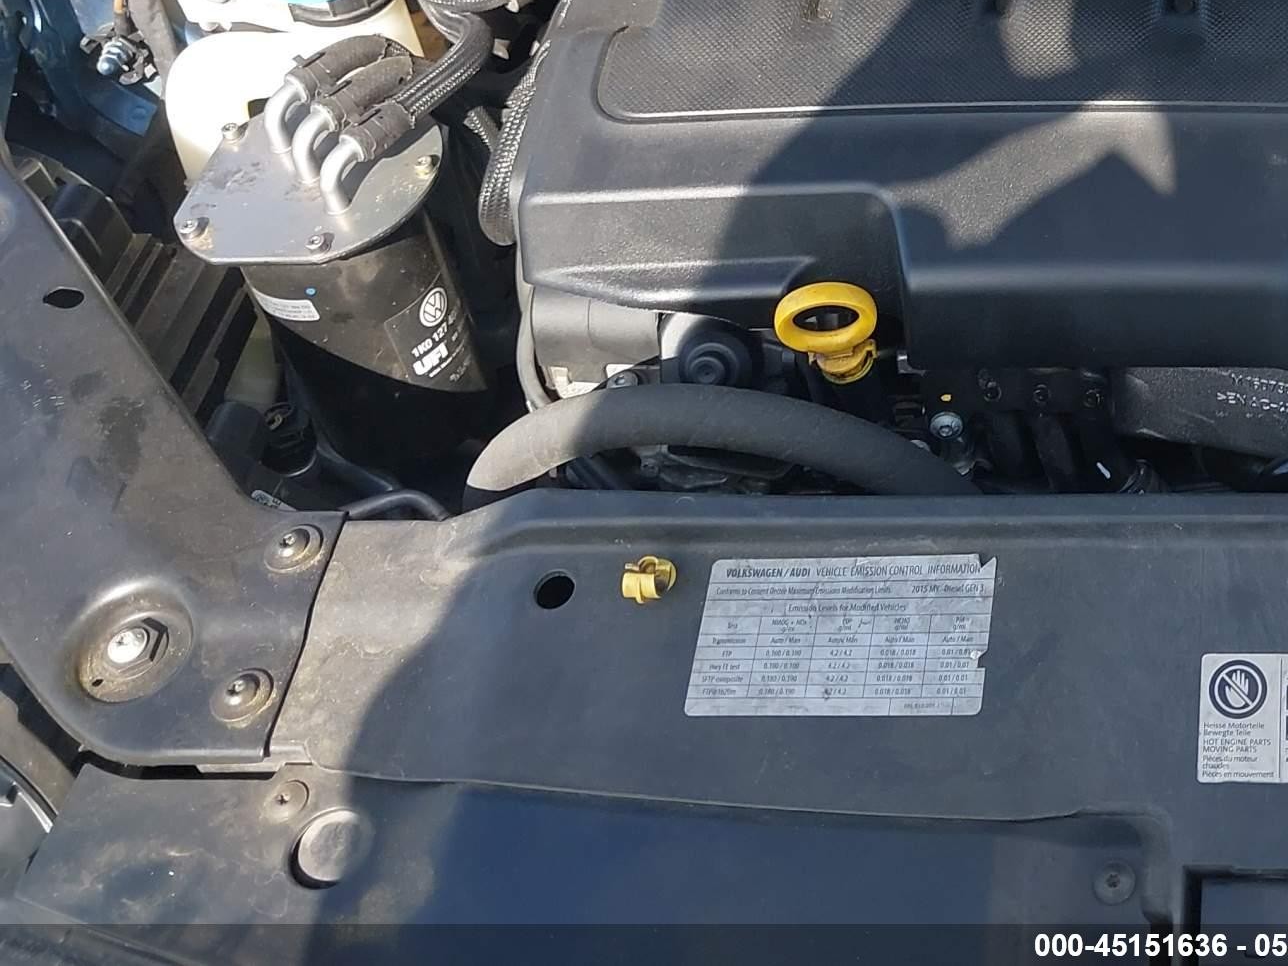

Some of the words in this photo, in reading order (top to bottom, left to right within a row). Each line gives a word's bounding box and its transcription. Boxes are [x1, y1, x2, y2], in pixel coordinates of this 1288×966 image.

[432, 322, 447, 342] 127
[726, 568, 782, 578] VOLKSWAGEN
[790, 568, 811, 578] AUDI
[816, 566, 847, 577] VEHICLE
[850, 565, 887, 576] EMISSION
[889, 565, 922, 575] CONTROL
[927, 563, 981, 574] INFORMATION
[911, 585, 928, 594] 2015
[788, 604, 816, 612] Emission
[818, 603, 838, 612] Levels
[850, 602, 879, 612] Modified
[881, 602, 906, 611] Vehicles
[1202, 745, 1234, 753] MOVING
[1235, 745, 1257, 753] PARTS
